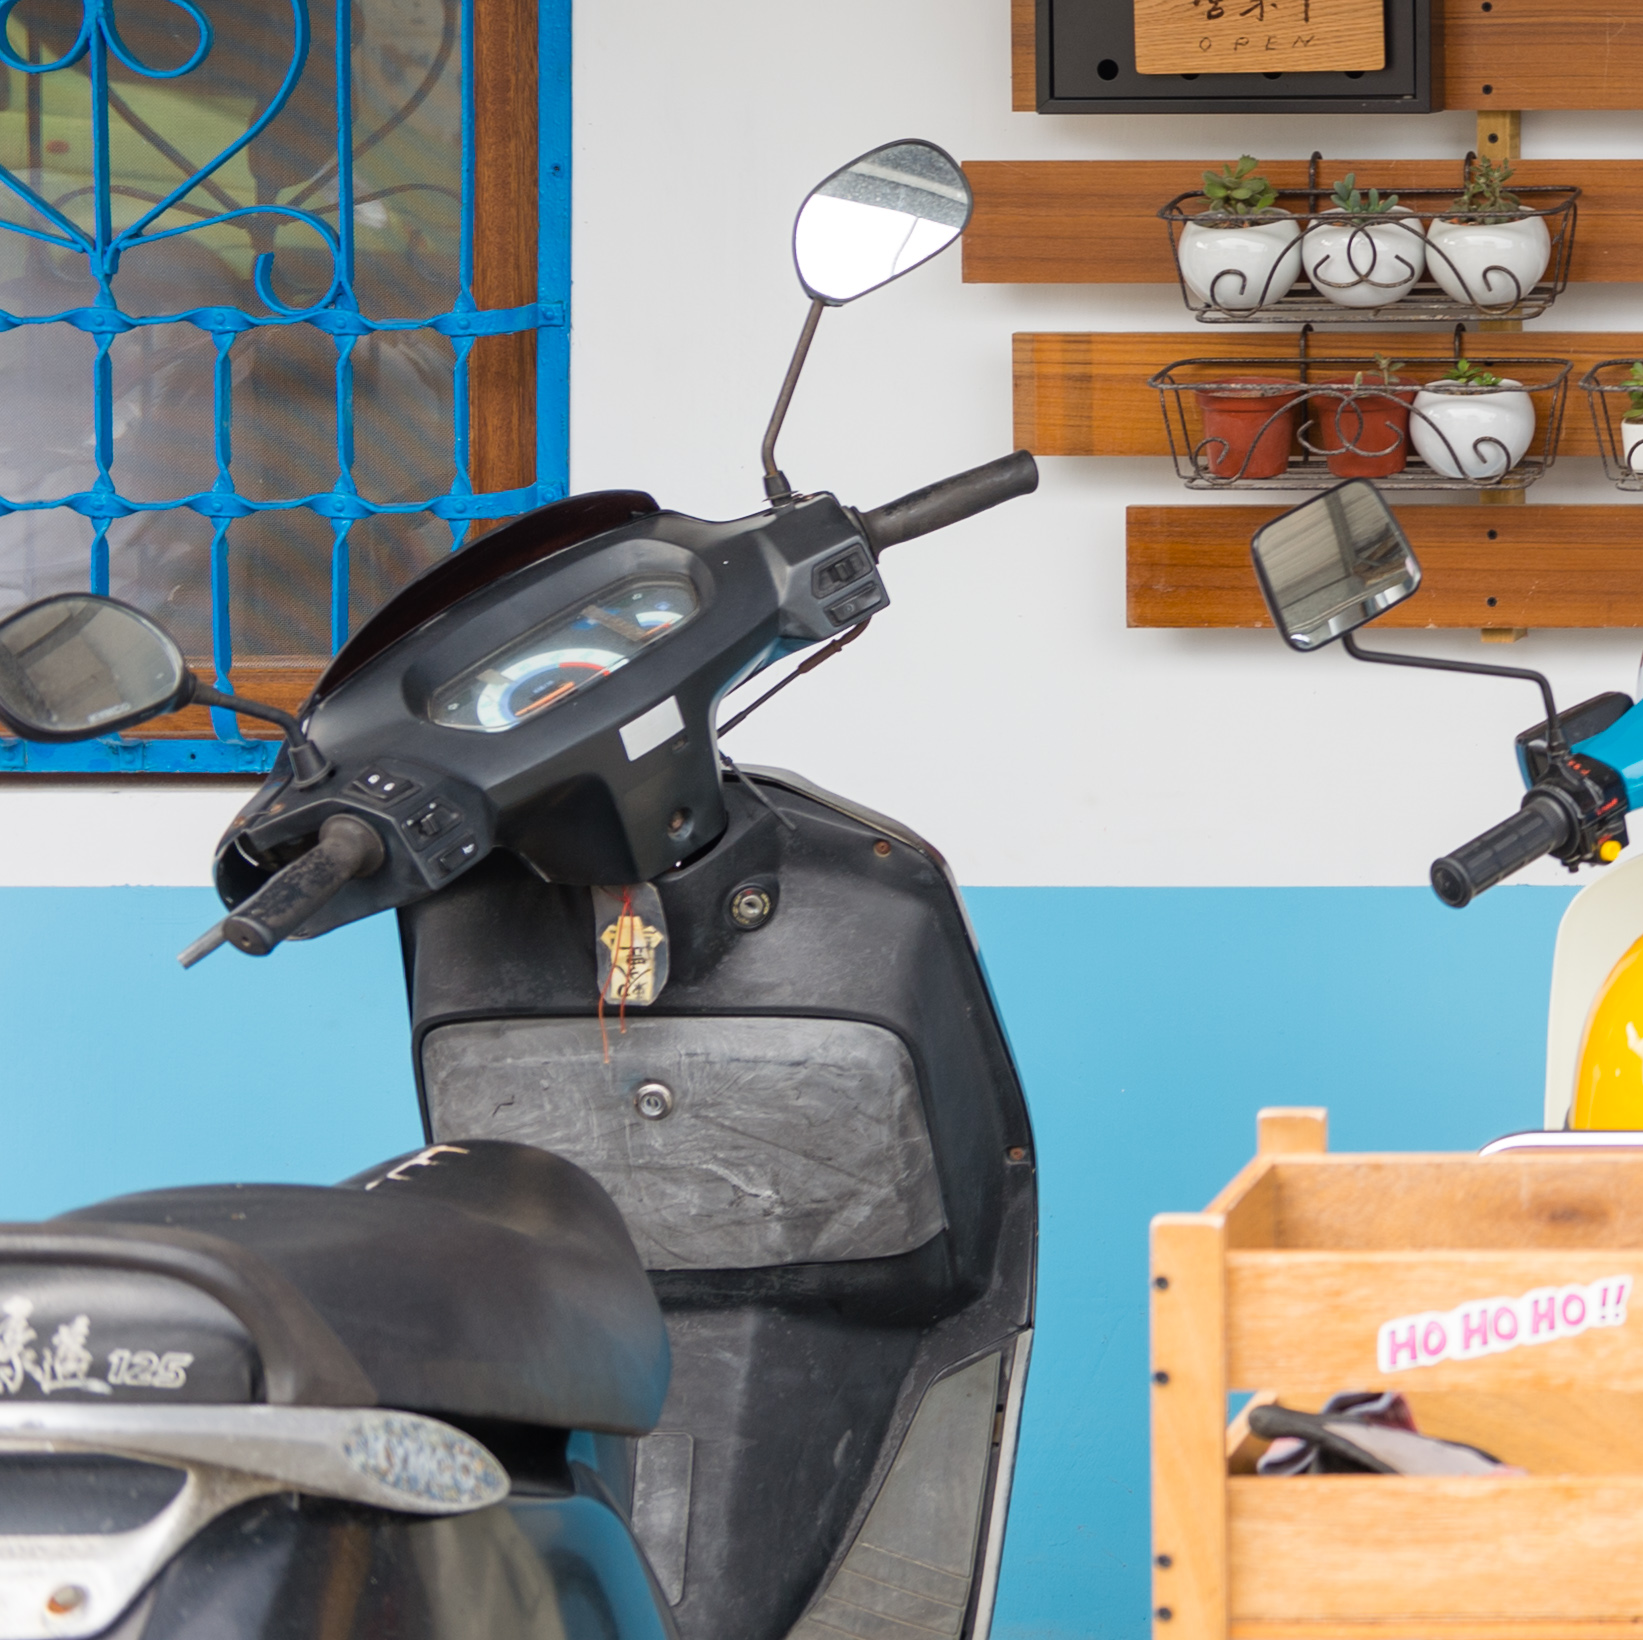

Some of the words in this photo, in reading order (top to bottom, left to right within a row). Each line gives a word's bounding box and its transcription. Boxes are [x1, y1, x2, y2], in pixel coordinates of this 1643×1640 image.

[1199, 34, 1317, 52] OPEN
[1389, 1321, 1447, 1365] HO
[1463, 1306, 1518, 1350] HO
[107, 1348, 194, 1389] 125
